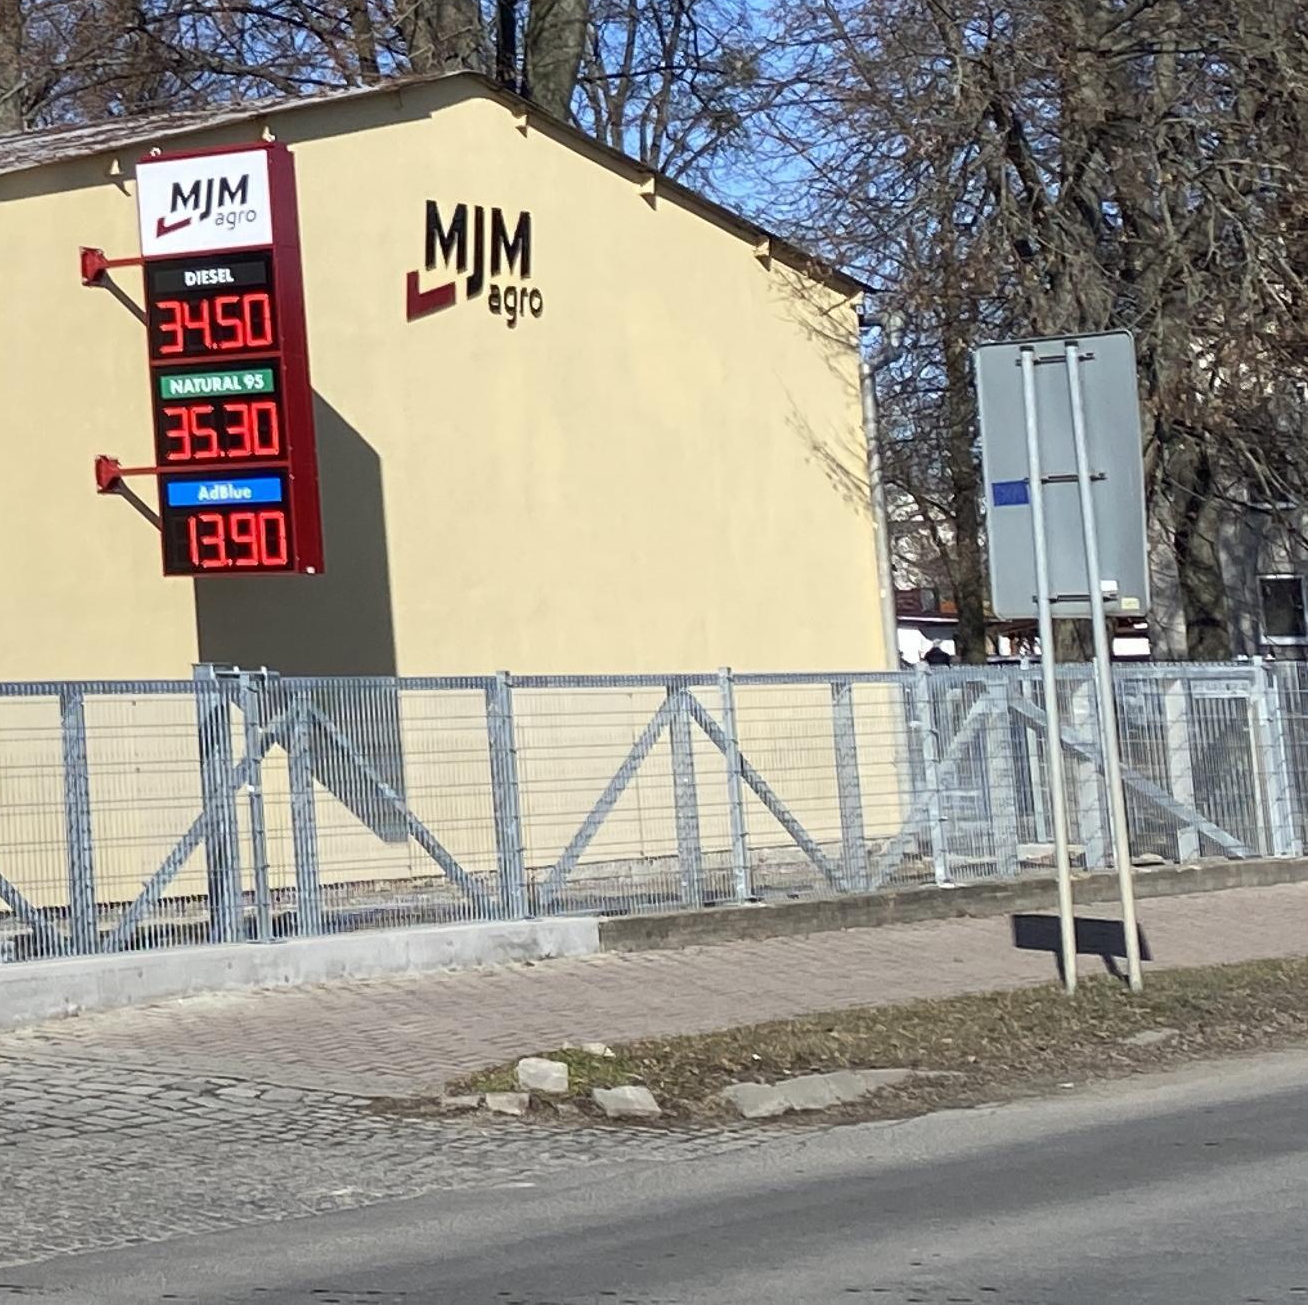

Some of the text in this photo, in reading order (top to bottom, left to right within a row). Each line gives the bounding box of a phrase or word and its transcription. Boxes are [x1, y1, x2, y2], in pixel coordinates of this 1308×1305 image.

[170, 174, 249, 221] MJM
[214, 209, 257, 230] agro
[425, 199, 532, 300] MJM
[184, 268, 234, 286] DIESEL
[156, 293, 273, 354] 34.50
[488, 284, 543, 329] agro
[169, 373, 264, 395] NATURAL 95
[163, 402, 280, 460] 35.30
[198, 483, 252, 501] AdBlue
[188, 510, 288, 568] 13.90
